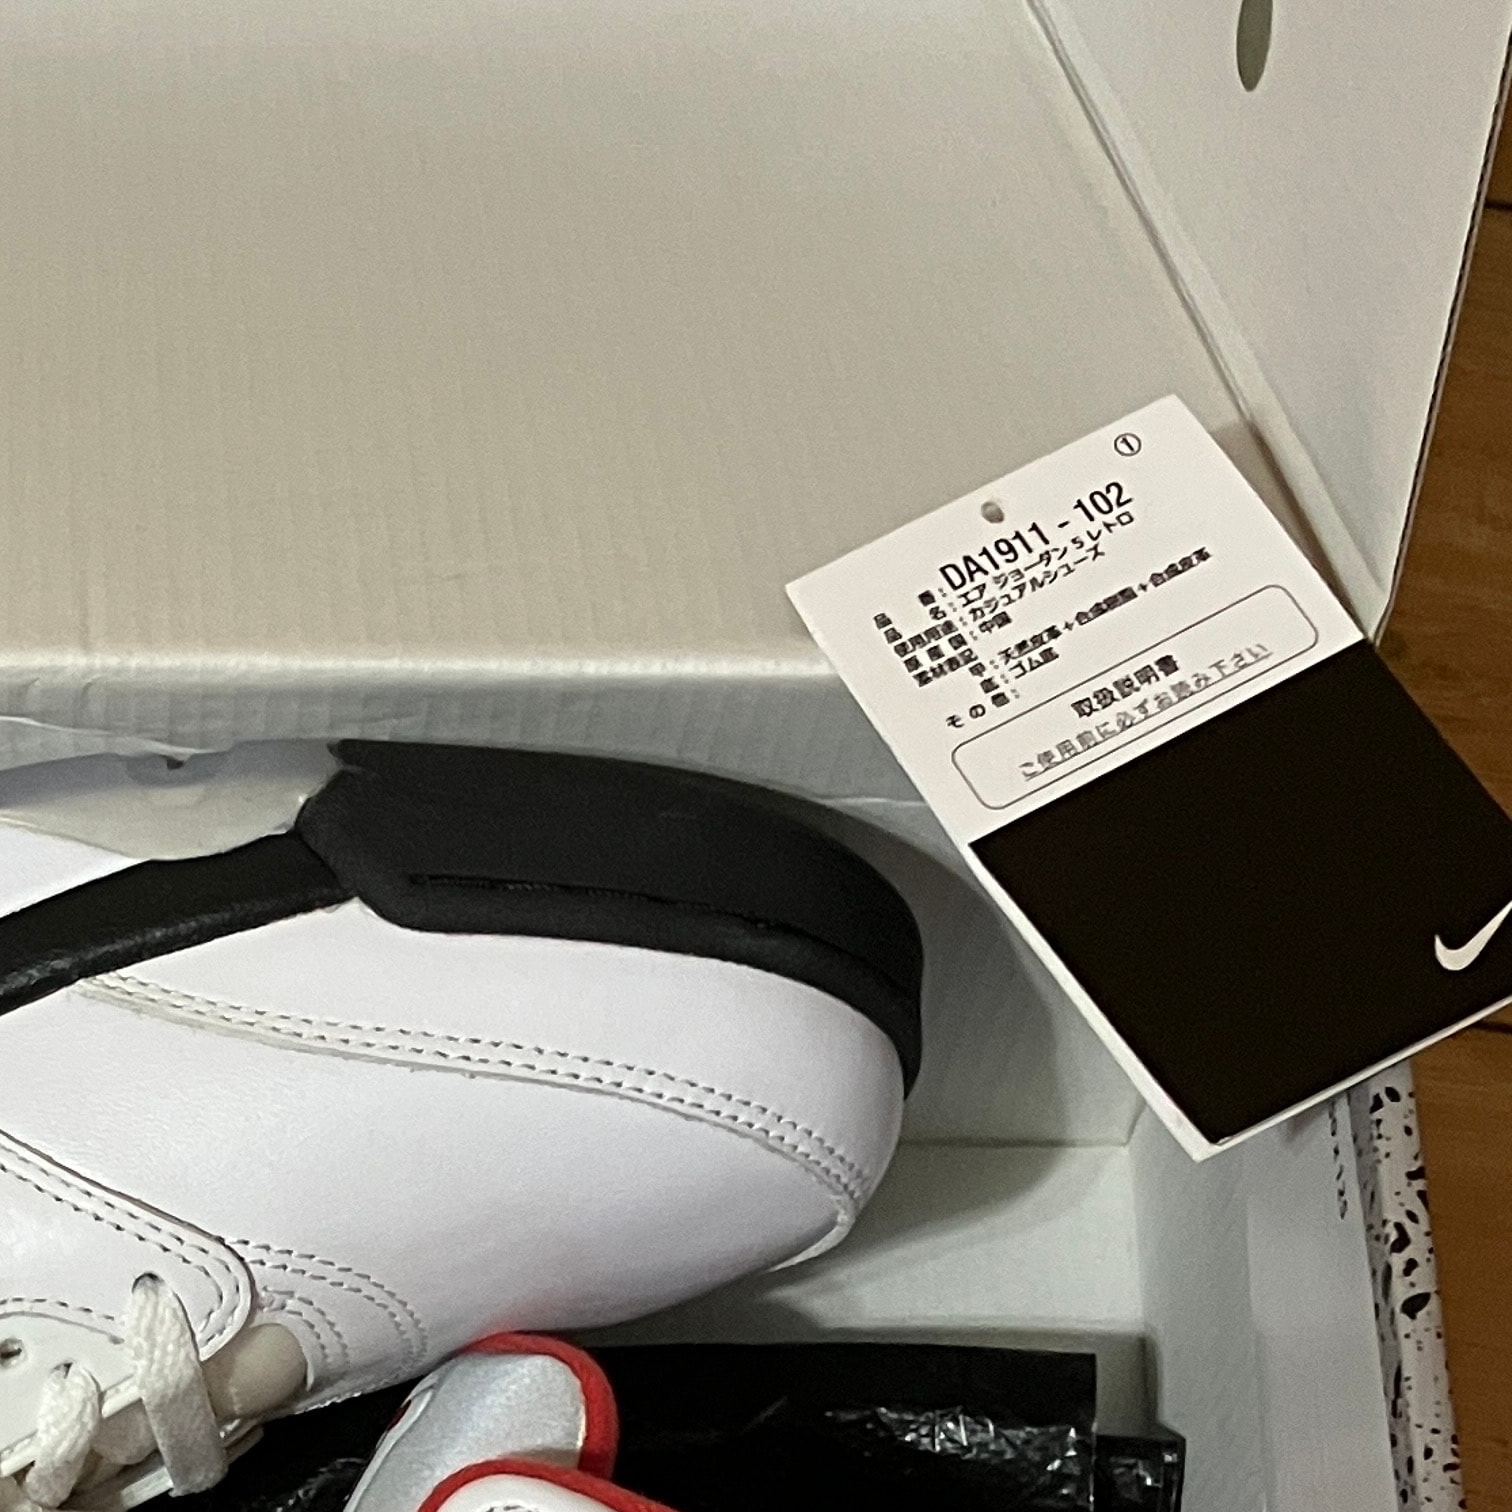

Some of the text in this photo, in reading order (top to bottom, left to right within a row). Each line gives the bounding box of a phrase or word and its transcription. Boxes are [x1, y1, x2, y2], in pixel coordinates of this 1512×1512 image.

[939, 522, 1050, 591] DA1911
[1073, 482, 1133, 522] 102
[1086, 511, 1134, 541] レトロ
[969, 542, 1105, 622] カジュアルシューズ
[978, 611, 1012, 634] 中国
[1071, 655, 1179, 718] 取扱説明書
